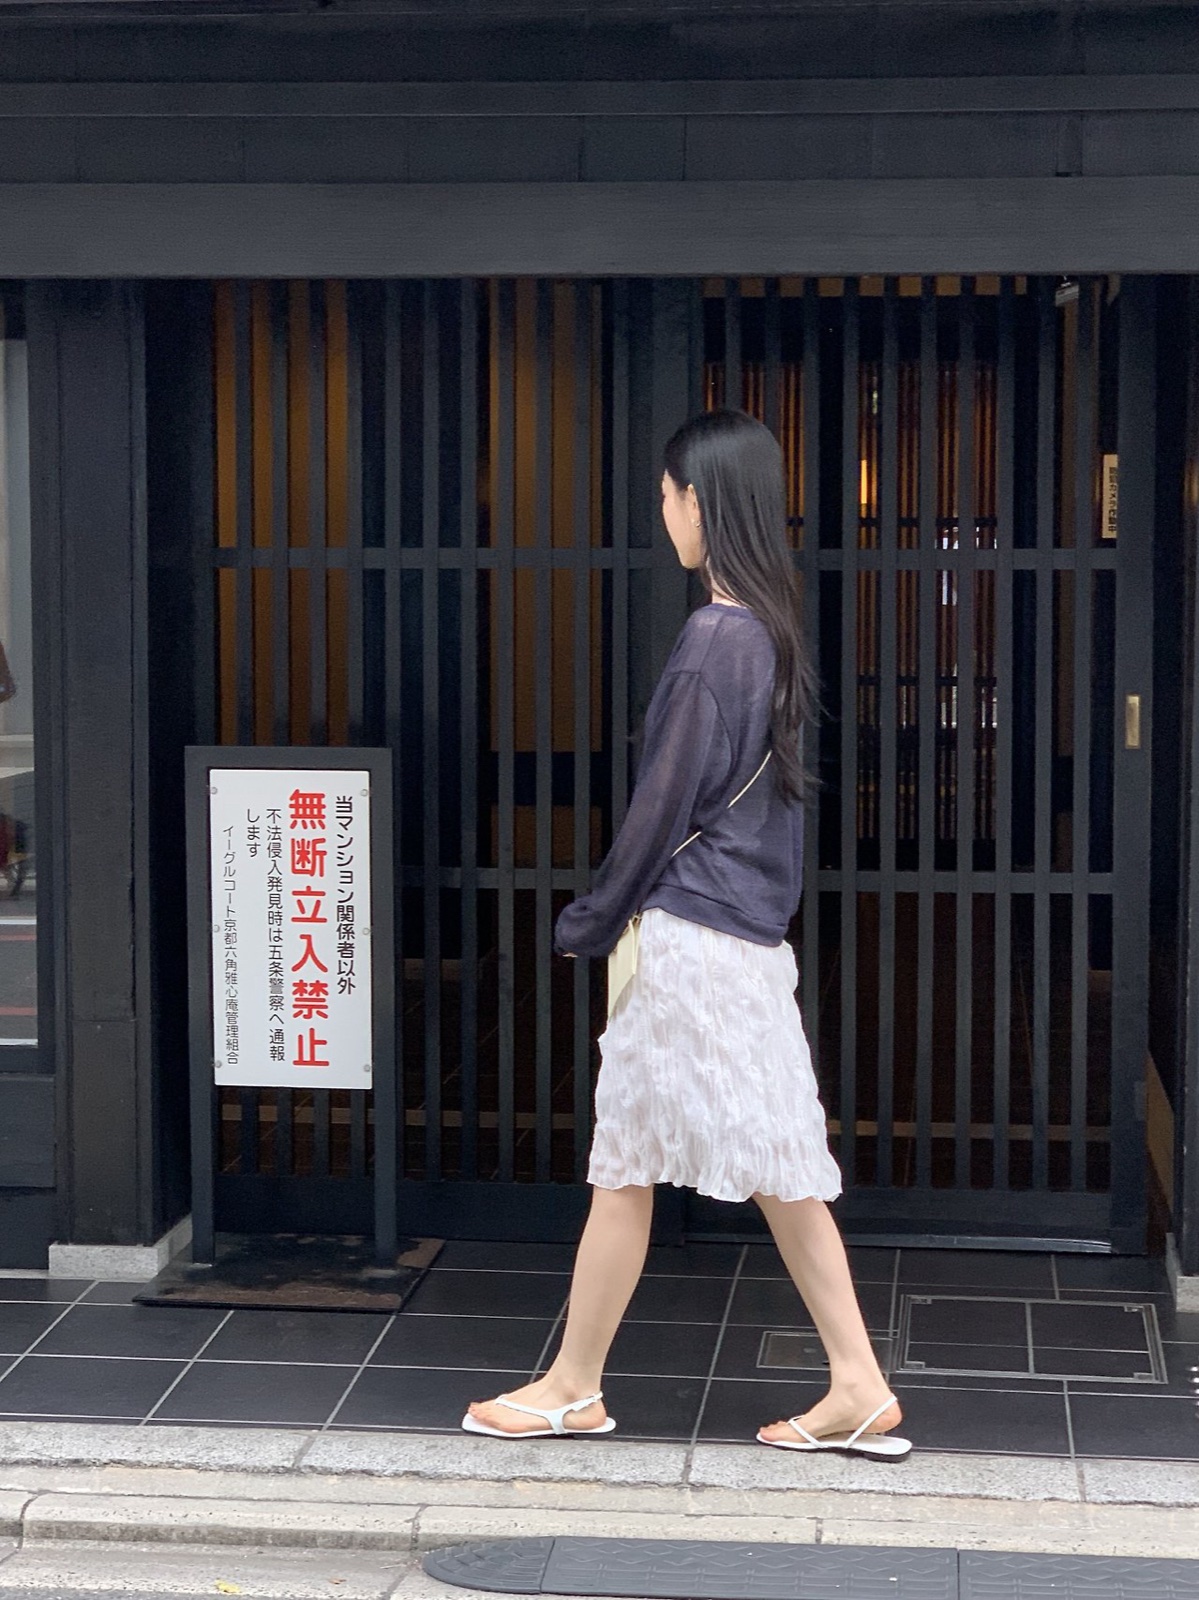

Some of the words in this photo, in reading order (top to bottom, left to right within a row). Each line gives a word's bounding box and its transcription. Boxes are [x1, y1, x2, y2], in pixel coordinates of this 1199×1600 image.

[221, 826, 239, 1066] イーグルコート京都六角雅心庵管理組合
[247, 809, 261, 857] します
[267, 809, 285, 1061] 不法侵入発見時は五条警察へ通報
[289, 789, 329, 1066] 無断立入禁止
[336, 796, 356, 994] 当マンション関係者以外
